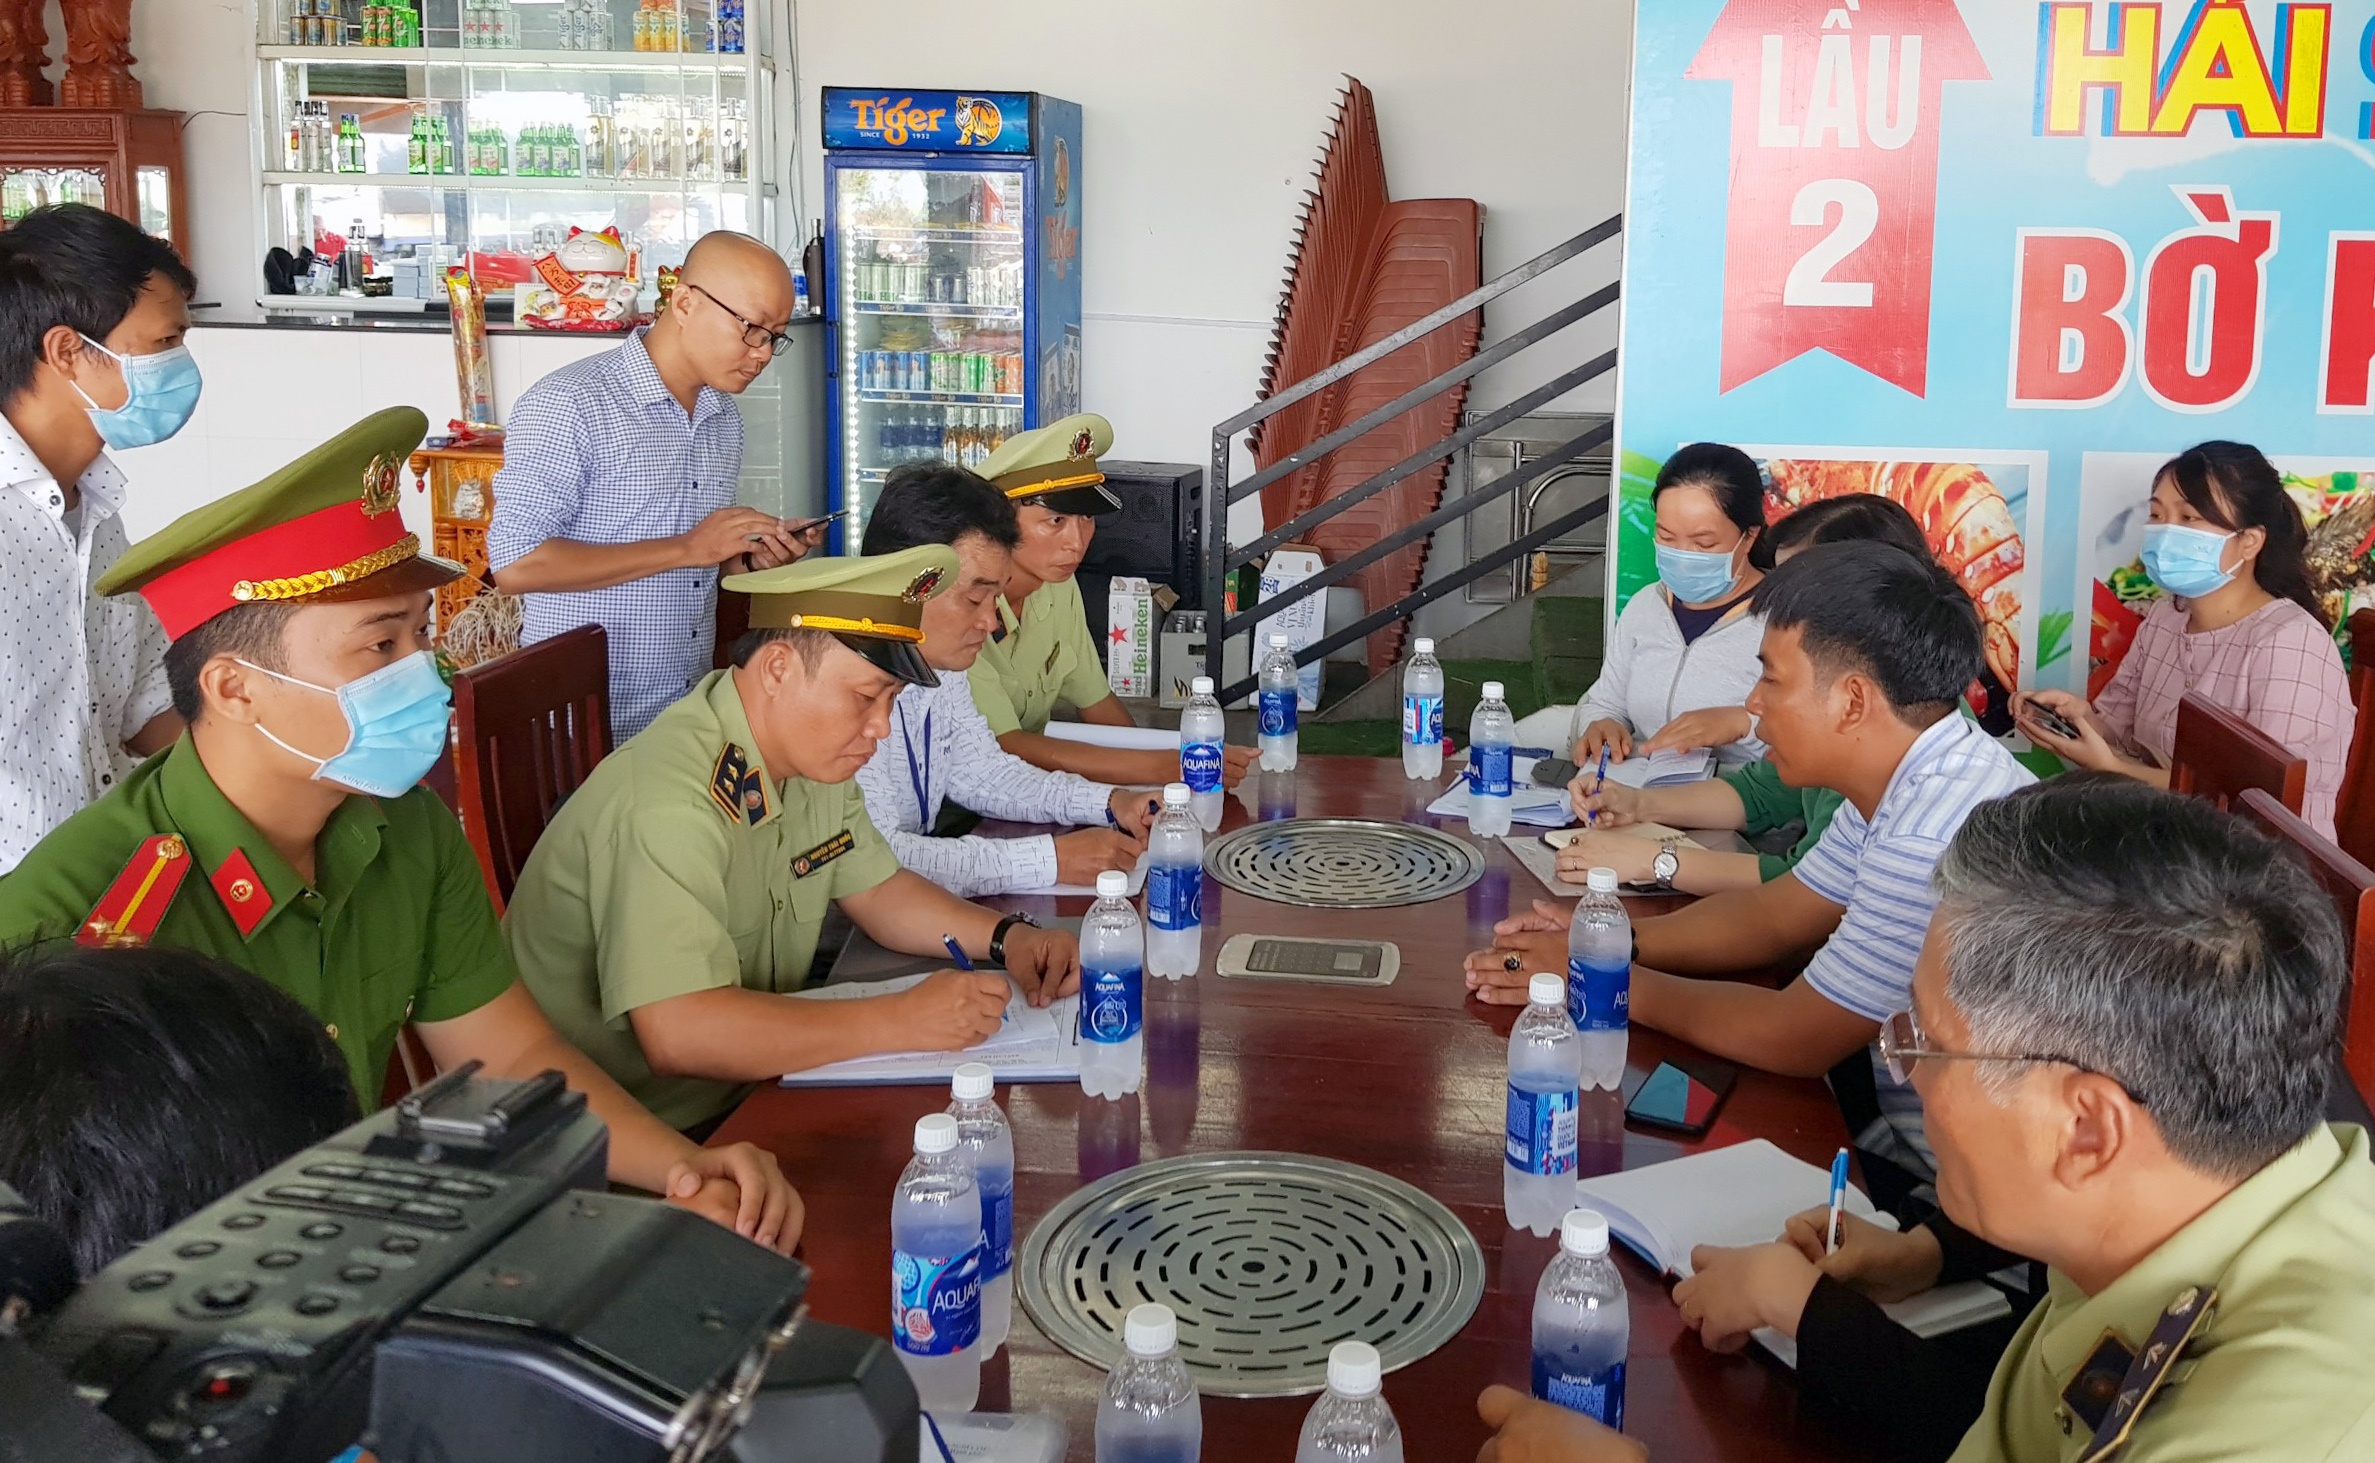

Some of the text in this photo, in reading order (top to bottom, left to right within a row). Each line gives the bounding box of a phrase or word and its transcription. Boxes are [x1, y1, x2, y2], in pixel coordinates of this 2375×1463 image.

[1758, 0, 1922, 150] LẦU
[2034, 0, 2332, 138] HẢI
[850, 96, 946, 146] Tiger
[860, 131, 880, 139] SINCE
[1783, 179, 1880, 308] 2
[2009, 186, 2279, 412] BỜ
[1263, 576, 1275, 594] 28
[1133, 598, 1148, 675] Heineken
[1183, 757, 1221, 771] AQUAFINA
[1095, 982, 1126, 992] AQUAFINA
[1561, 1373, 1593, 1386] AQUAFINA
